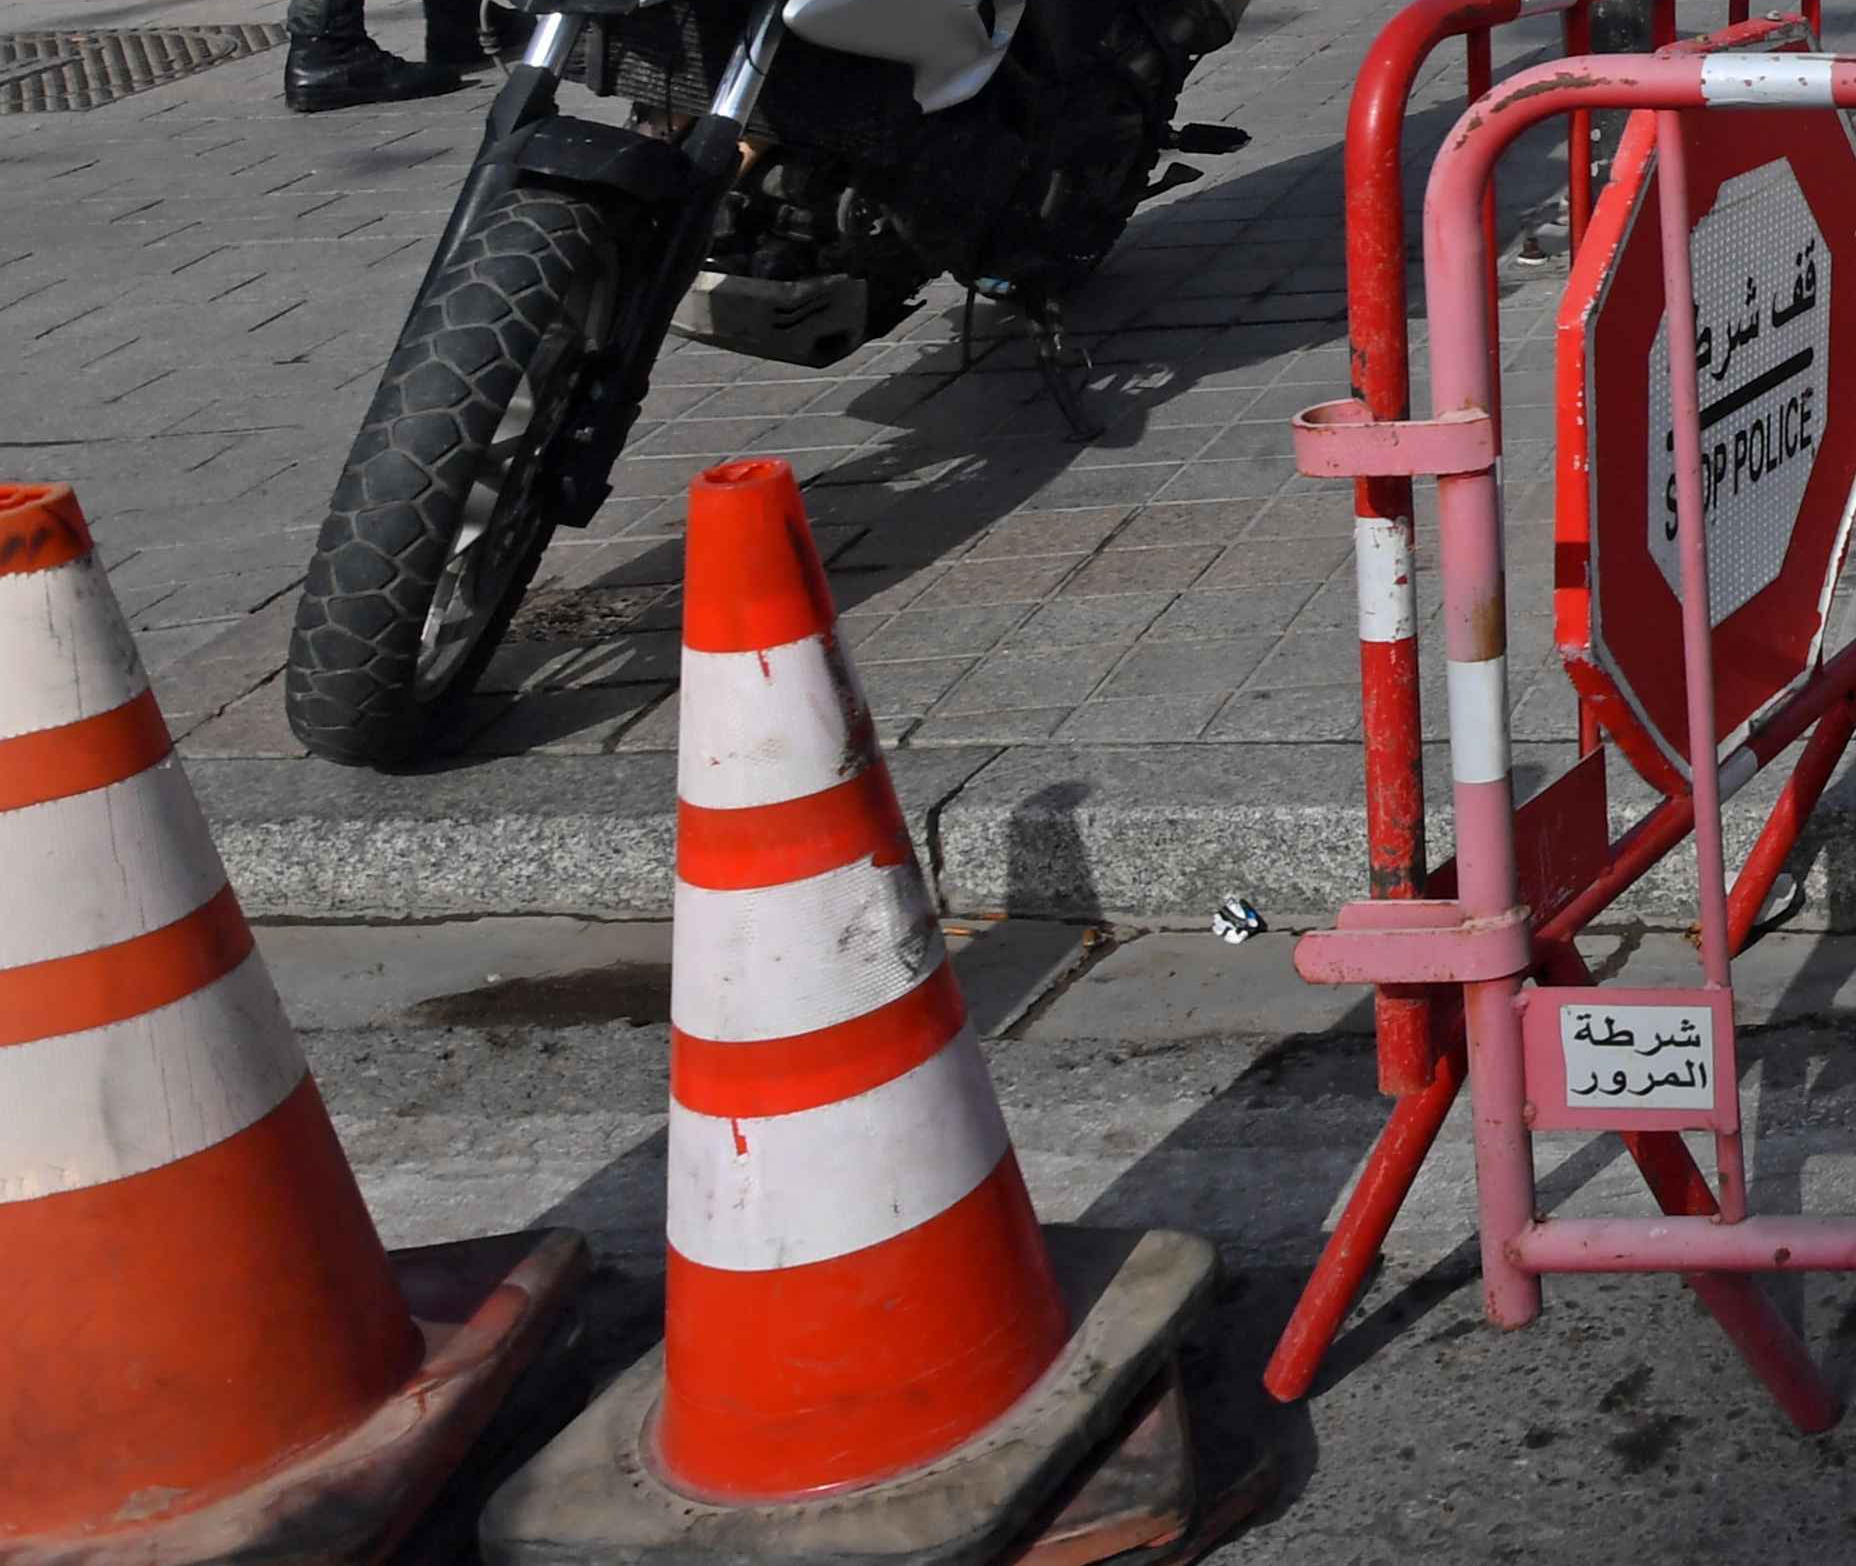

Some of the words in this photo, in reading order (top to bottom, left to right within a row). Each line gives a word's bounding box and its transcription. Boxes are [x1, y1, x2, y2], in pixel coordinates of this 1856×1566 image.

[1772, 239, 1816, 329] قف
[1735, 387, 1814, 495] POLICE
[1573, 1013, 1702, 1056] شرطة
[1570, 1058, 1708, 1096] المرور
